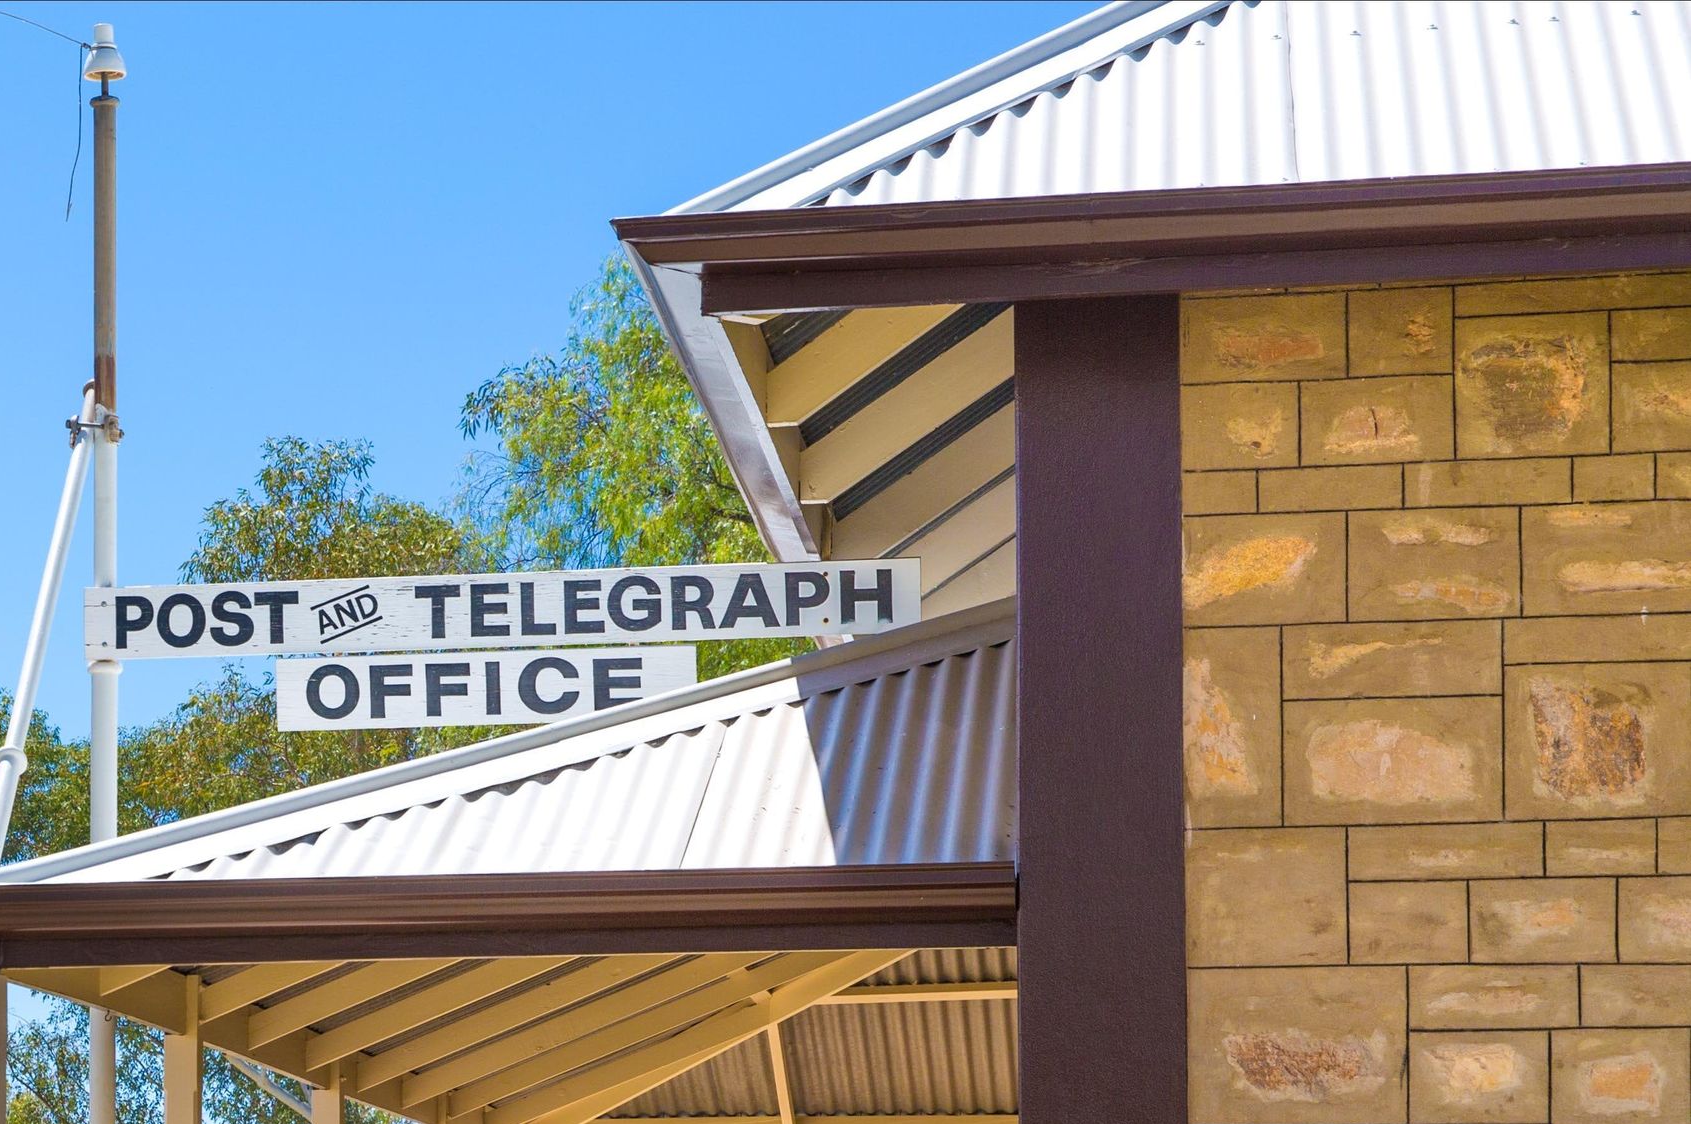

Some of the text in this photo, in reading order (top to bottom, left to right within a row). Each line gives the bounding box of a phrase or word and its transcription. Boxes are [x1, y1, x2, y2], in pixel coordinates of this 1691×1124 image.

[115, 568, 894, 649] POST AND TELEGRAPH
[307, 657, 643, 720] OFFICE
